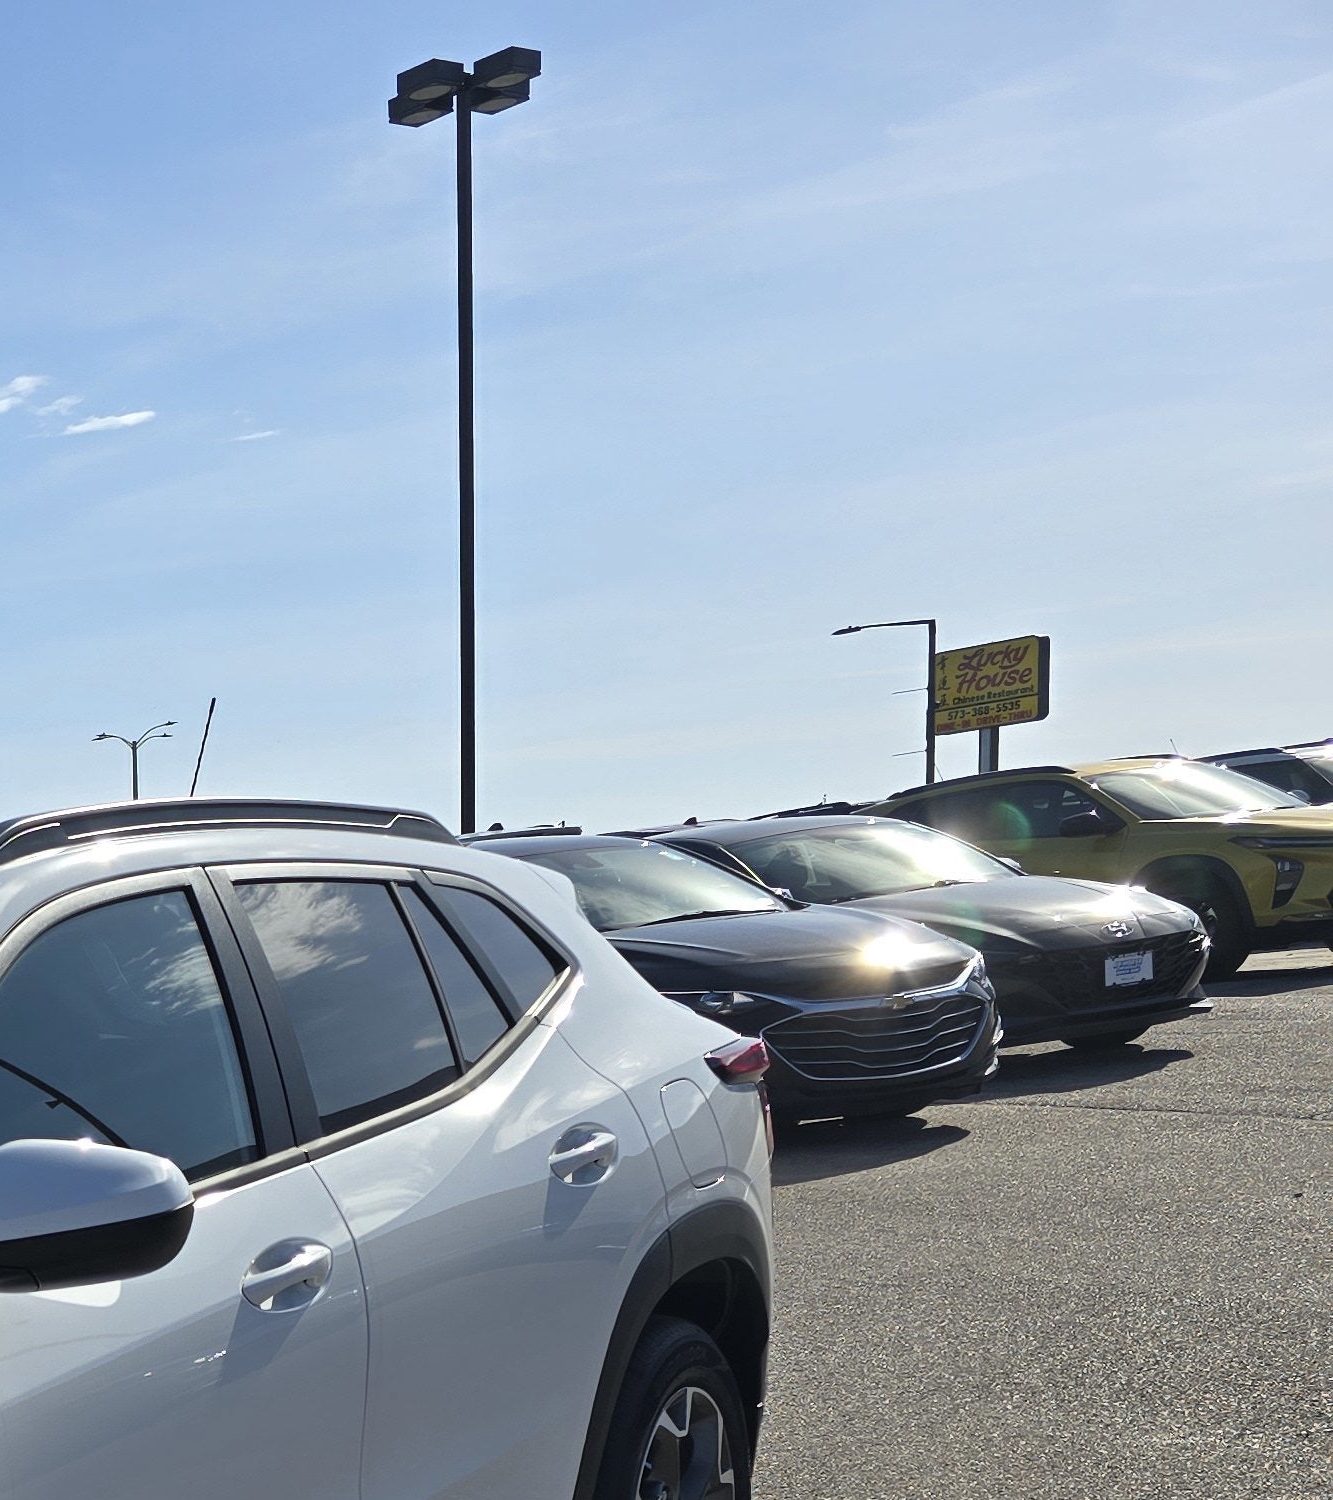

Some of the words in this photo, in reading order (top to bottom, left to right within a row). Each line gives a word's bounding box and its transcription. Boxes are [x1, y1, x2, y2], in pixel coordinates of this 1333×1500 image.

[957, 644, 1031, 672] Lucky
[955, 667, 1033, 695] House
[952, 694, 986, 706] Chinese
[987, 684, 1035, 700] Restaurant
[947, 700, 1022, 721] 573-368-5535
